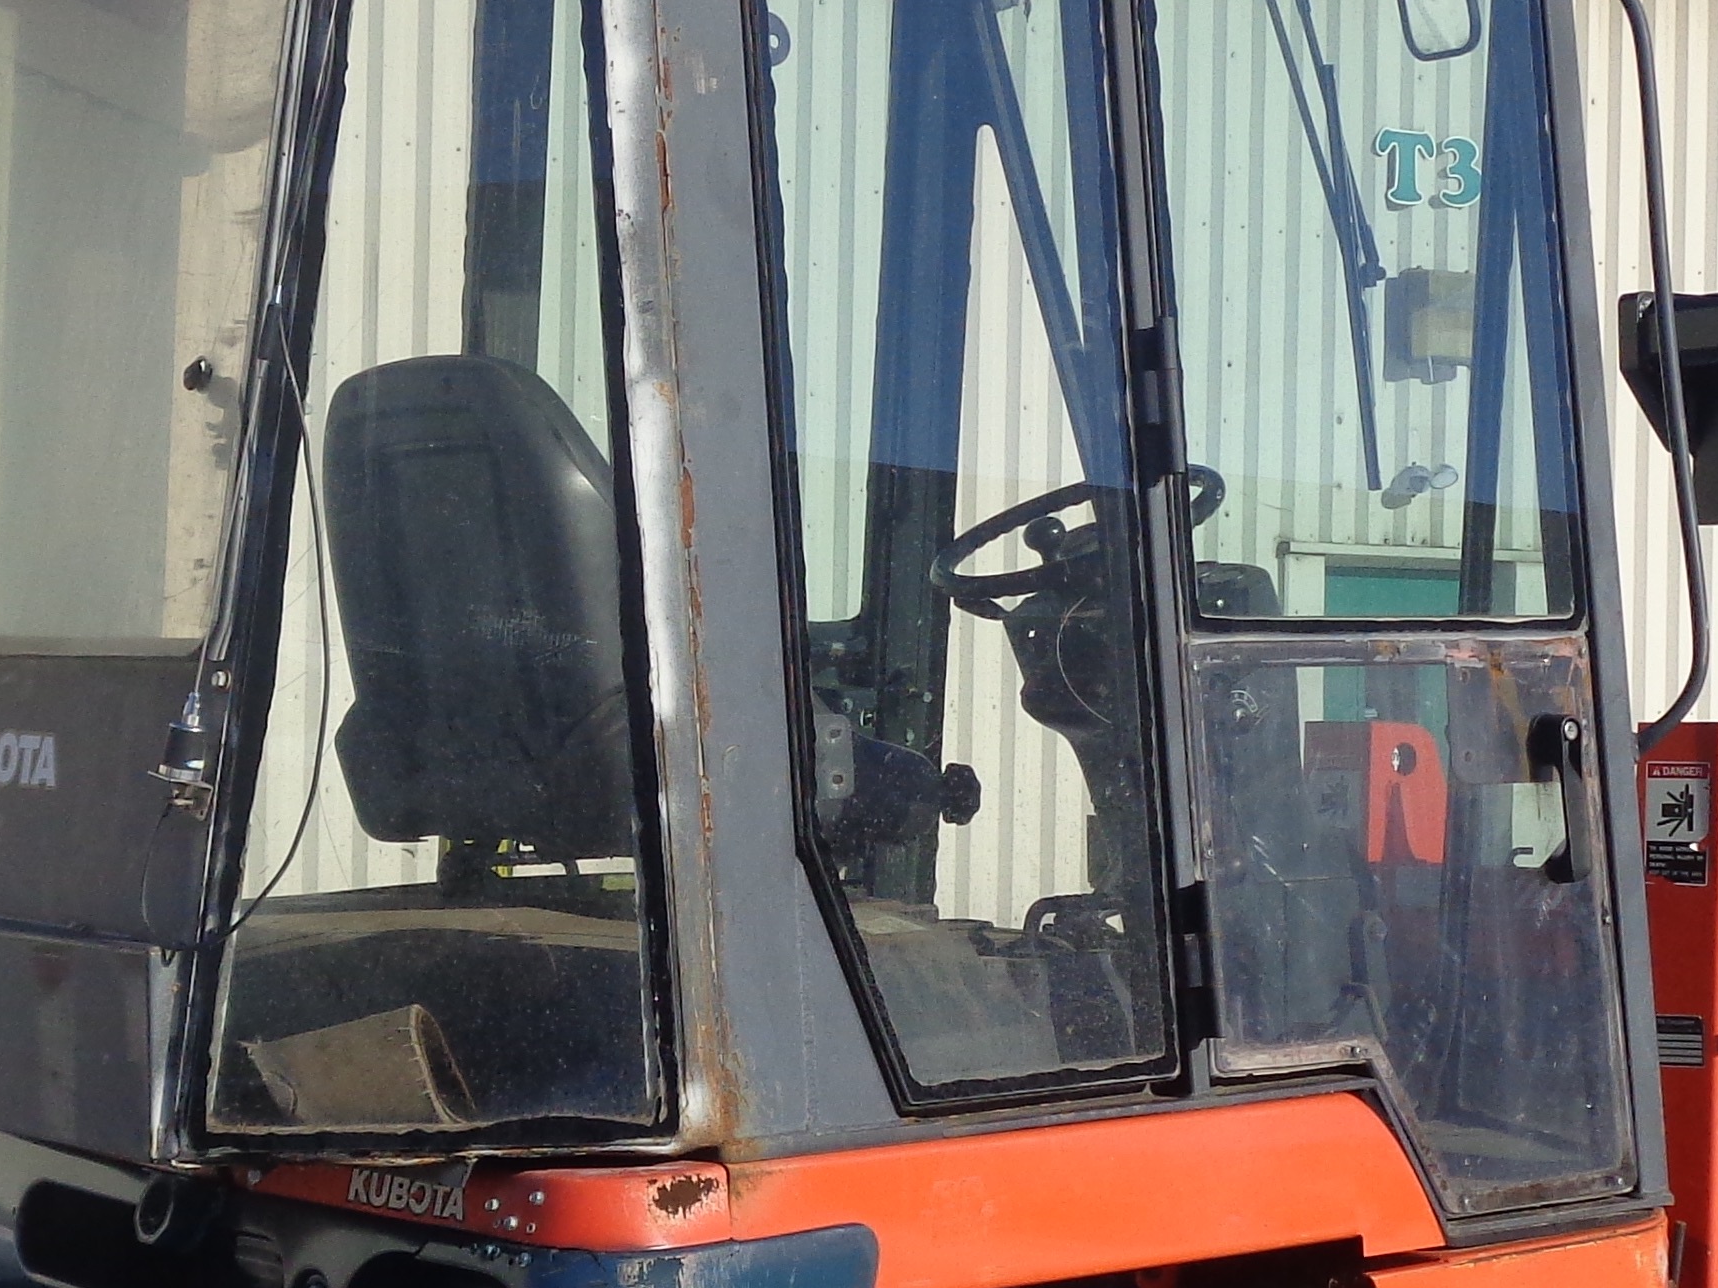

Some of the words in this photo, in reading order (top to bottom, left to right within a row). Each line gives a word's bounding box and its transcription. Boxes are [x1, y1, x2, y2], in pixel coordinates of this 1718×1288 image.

[1376, 127, 1482, 207] T3
[1661, 765, 1703, 777] DANGER
[347, 1167, 465, 1221] KUBOTA
